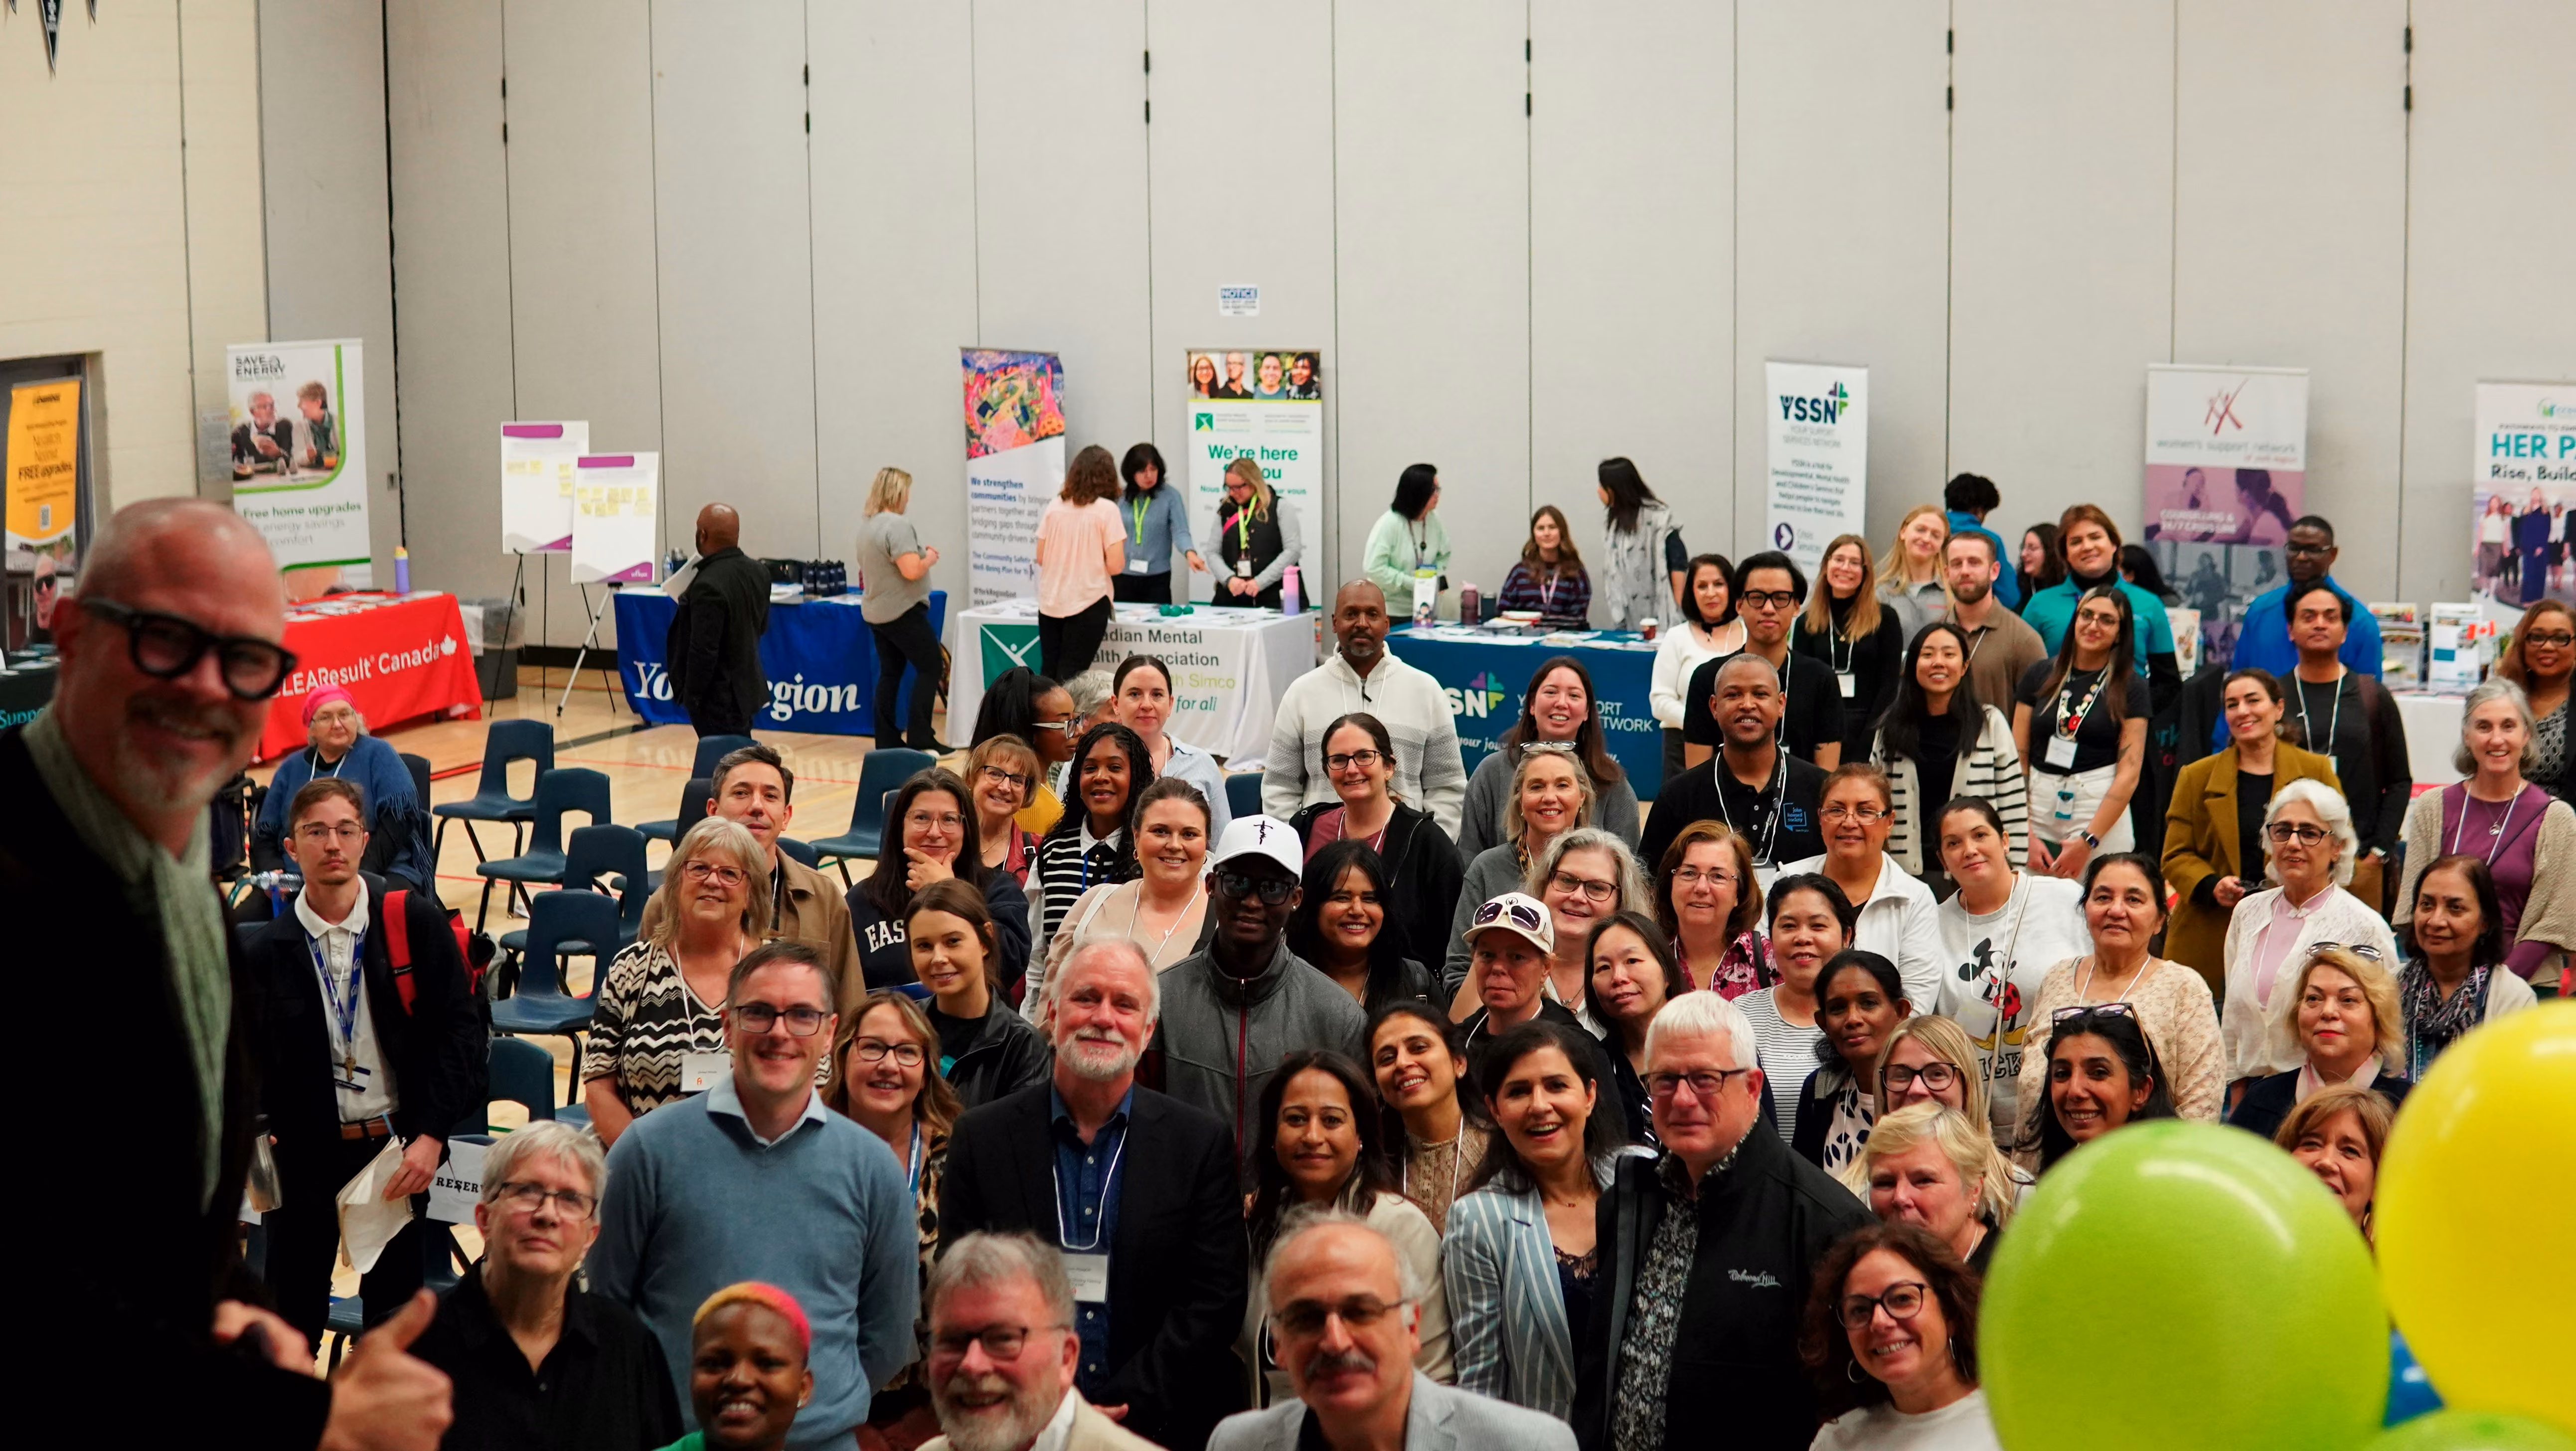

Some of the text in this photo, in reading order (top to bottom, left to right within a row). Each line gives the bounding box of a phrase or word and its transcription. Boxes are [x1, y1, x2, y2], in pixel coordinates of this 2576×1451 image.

[1221, 288, 1257, 298] NOTICE
[236, 355, 265, 367] SAVE
[236, 364, 286, 377] ENERGY
[1780, 395, 1837, 424] YSSN
[1208, 444, 1298, 460] We're here
[2492, 433, 2576, 459] HER P
[1262, 468, 1282, 479] ou
[2492, 464, 2532, 482] Rise,
[971, 477, 1023, 490] We strengthen
[1201, 485, 1220, 493] Nous
[971, 492, 1016, 502] communities
[1018, 494, 1026, 505] by
[243, 501, 361, 519] Free home upgrades
[972, 505, 1038, 517] partners together and
[264, 518, 345, 534] energy savings
[972, 518, 996, 529] bridging
[999, 521, 1013, 530] gaps
[270, 535, 313, 547] comfort
[1101, 629, 1202, 644] adian Mental
[1092, 649, 1120, 663] alth
[272, 639, 439, 699] LEAResult Canada
[633, 661, 861, 722] Yo gion
[1175, 696, 1196, 714] for
[1444, 687, 1487, 718] SN
[1978, 1052, 2022, 1082] ICK
[436, 1177, 483, 1193] RESER
